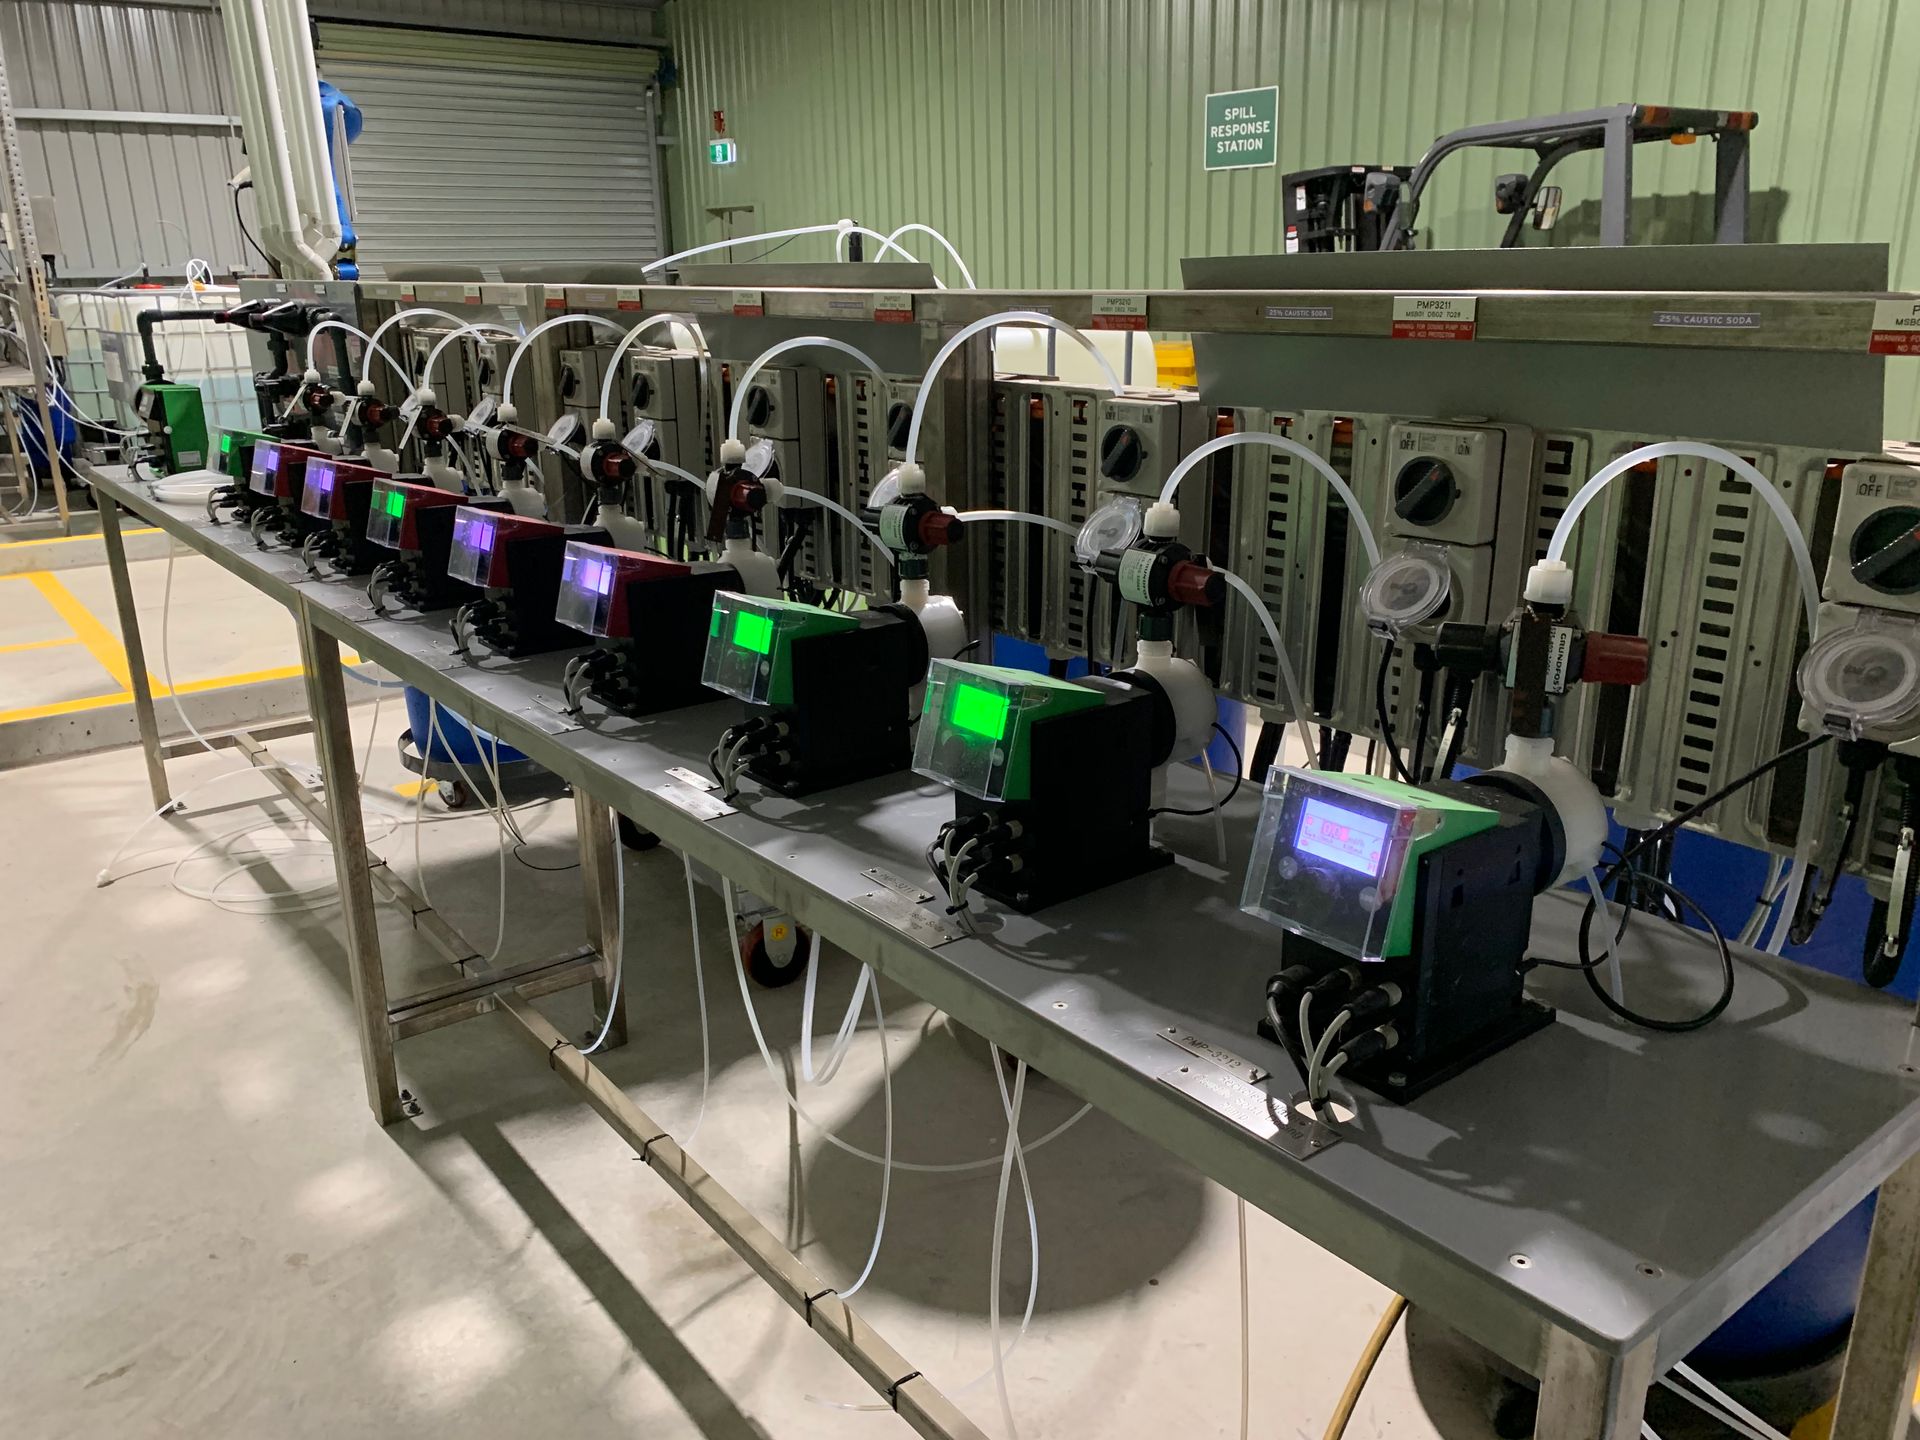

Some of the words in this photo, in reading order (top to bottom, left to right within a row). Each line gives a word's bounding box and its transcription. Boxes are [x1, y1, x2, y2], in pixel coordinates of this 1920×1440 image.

[1224, 106, 1257, 121] SPILL
[1210, 120, 1270, 138] RESPONSE
[1217, 138, 1263, 154] STATION
[1416, 300, 1451, 309] PMP3211
[1683, 315, 1722, 325] CAUSTIC
[1726, 316, 1752, 325] SODA
[1399, 439, 1415, 450] OFF
[1859, 483, 1883, 497] OFF
[1552, 632, 1567, 686] GRUNDFOS
[1182, 1035, 1242, 1069] PMP-3212
